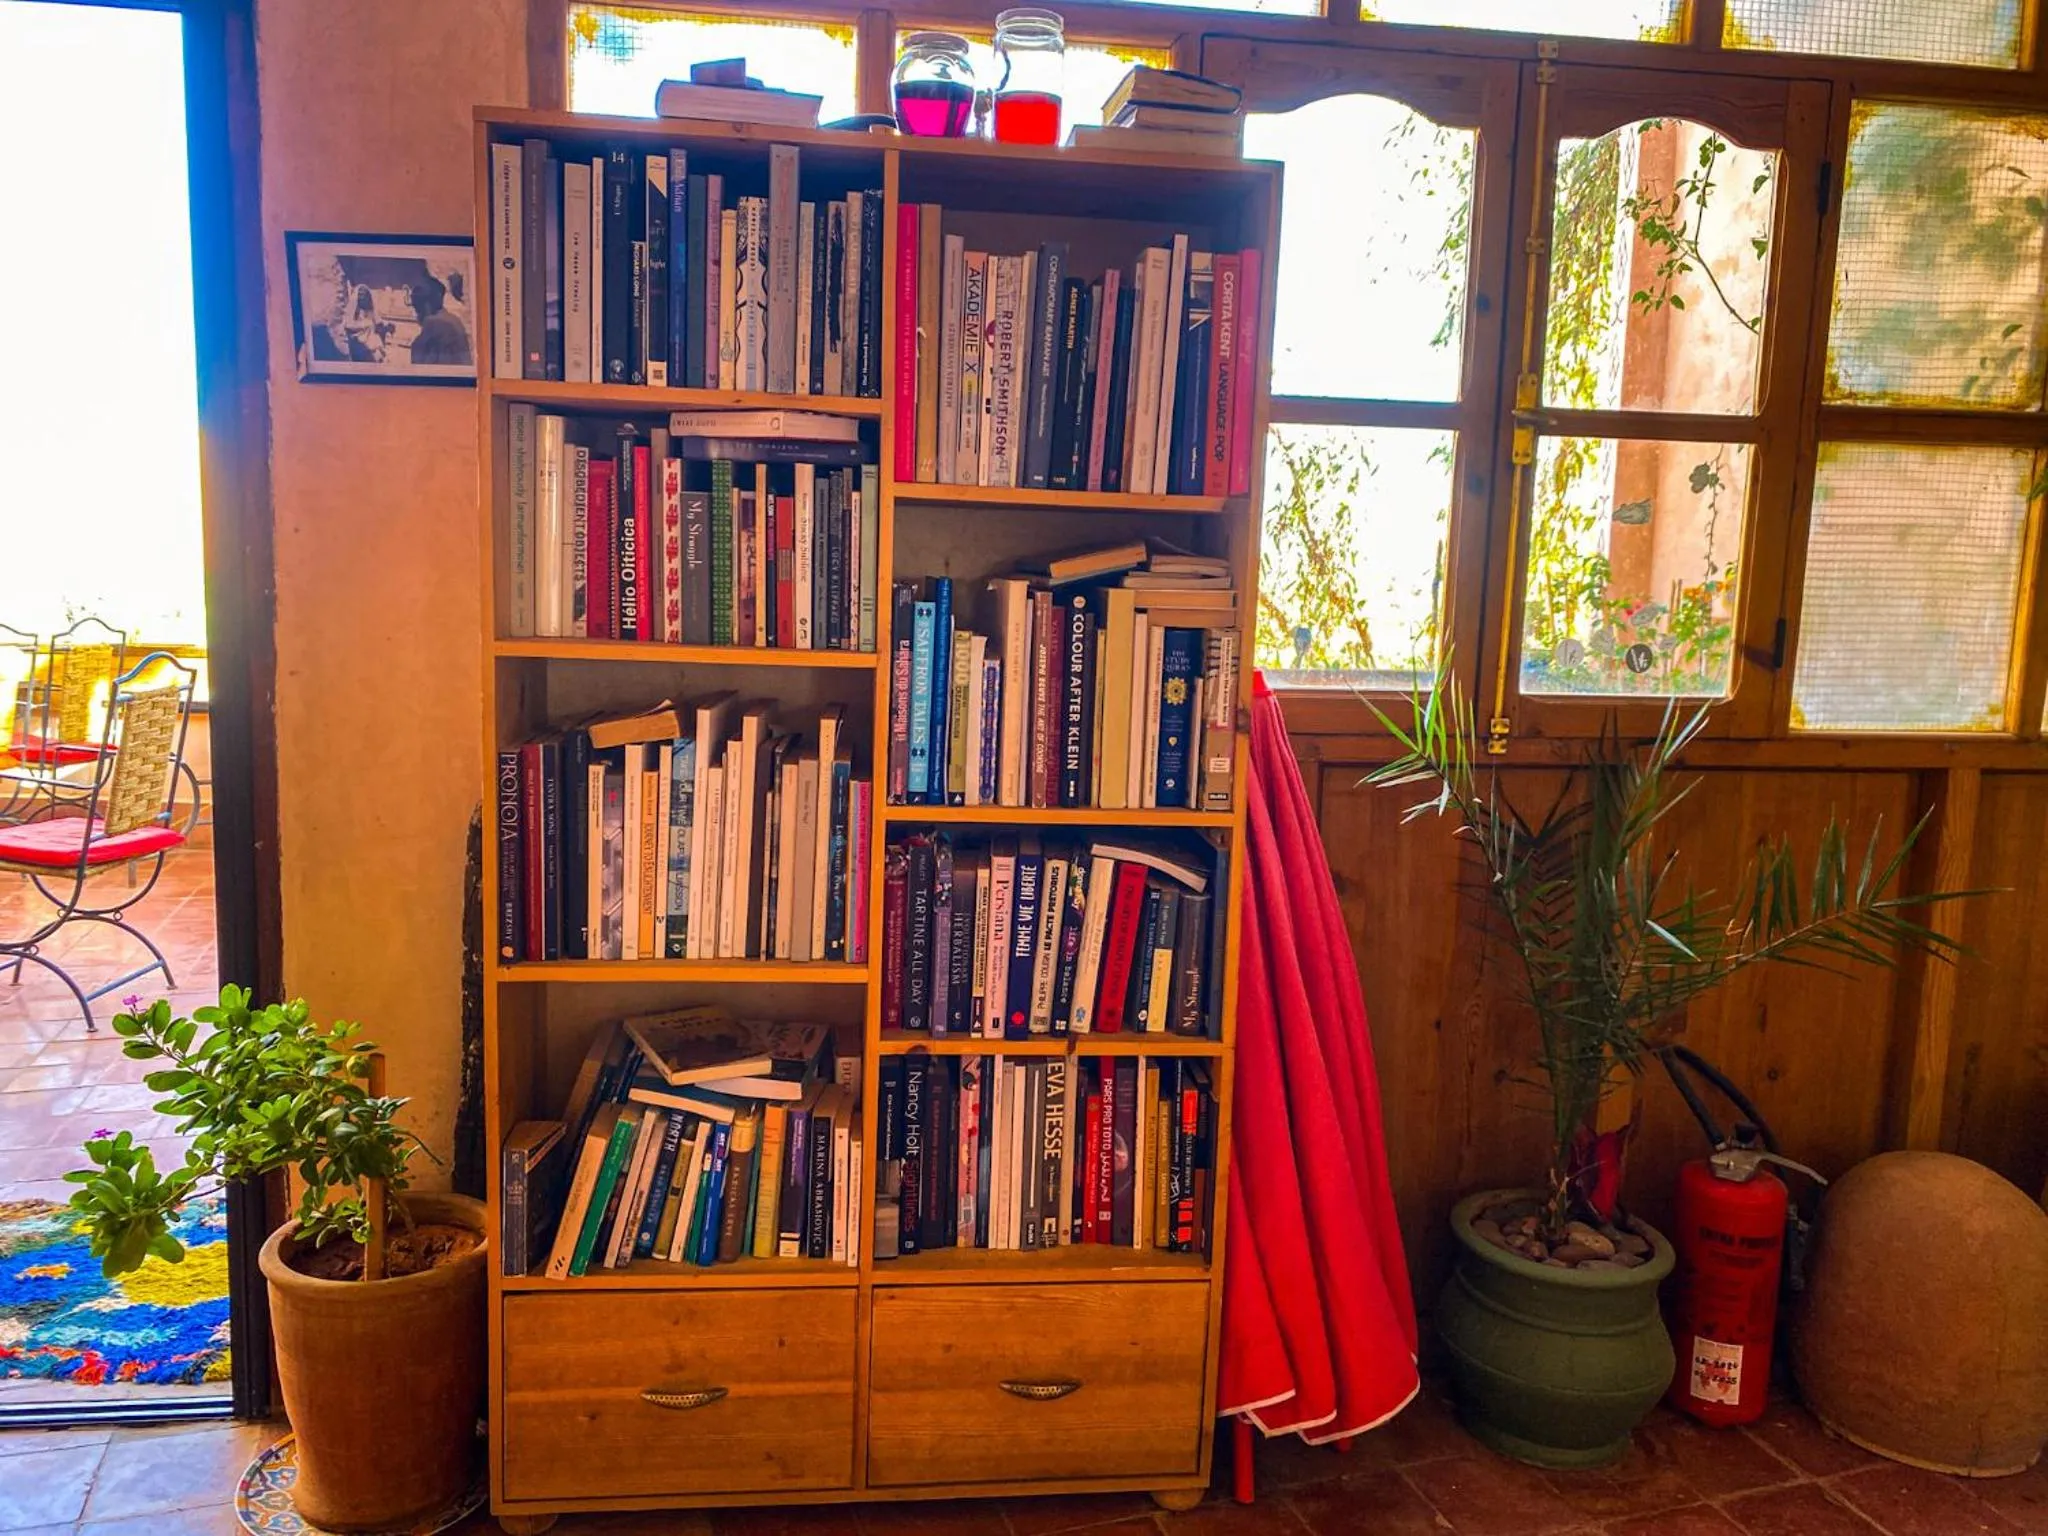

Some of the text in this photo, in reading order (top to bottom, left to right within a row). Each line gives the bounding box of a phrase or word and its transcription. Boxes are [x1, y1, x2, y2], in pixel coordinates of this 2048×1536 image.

[612, 152, 625, 163] 14
[673, 182, 685, 213] Adnan
[965, 267, 981, 372] AKADEMIE X
[1045, 255, 1059, 325] CONTEMPORARY
[1067, 317, 1075, 349] MARTIN
[1214, 271, 1235, 463] CORITA KENT LANGUAGE POP
[996, 310, 1014, 457] ROBERT SMITHSON
[1041, 362, 1051, 377] ART
[573, 450, 586, 586] DISOBEDIENT OBJECTS
[687, 500, 703, 570] My Struggle
[622, 518, 636, 629] Hélio Oiticica
[894, 639, 909, 733] Maisons du Sahara
[913, 626, 928, 744] SAFFRON TALES
[955, 643, 972, 685] 1000
[1038, 644, 1047, 676] JOSEPH
[1038, 677, 1046, 702] BEUYS
[1067, 614, 1084, 770] COLOUR AFTER KLEIN
[1037, 703, 1046, 716] THE
[501, 754, 517, 841] PRONOIA
[677, 755, 688, 826] TAKE YOUR TIME
[642, 823, 653, 915] JOURNEY TO ENLIGHTENMENT
[833, 874, 843, 901] POWER
[993, 879, 1010, 941] Persiana
[1016, 925, 1032, 957] FEMME
[1018, 904, 1034, 921] VIE
[1044, 915, 1054, 940] PACTE
[910, 888, 926, 1005] TARTINE ALL DAY
[951, 912, 963, 984] HERBALISM
[1043, 941, 1052, 951] LE
[1060, 925, 1078, 1004] life in balance
[1182, 967, 1199, 1028] My Struggle
[664, 1113, 682, 1152] NORTH
[1044, 1062, 1064, 1160] EVA HESSE
[1103, 1078, 1112, 1149] PARS PRO TOTO
[815, 1135, 826, 1177] MARINA
[903, 1070, 923, 1232] Nancy Holt Sightlines
